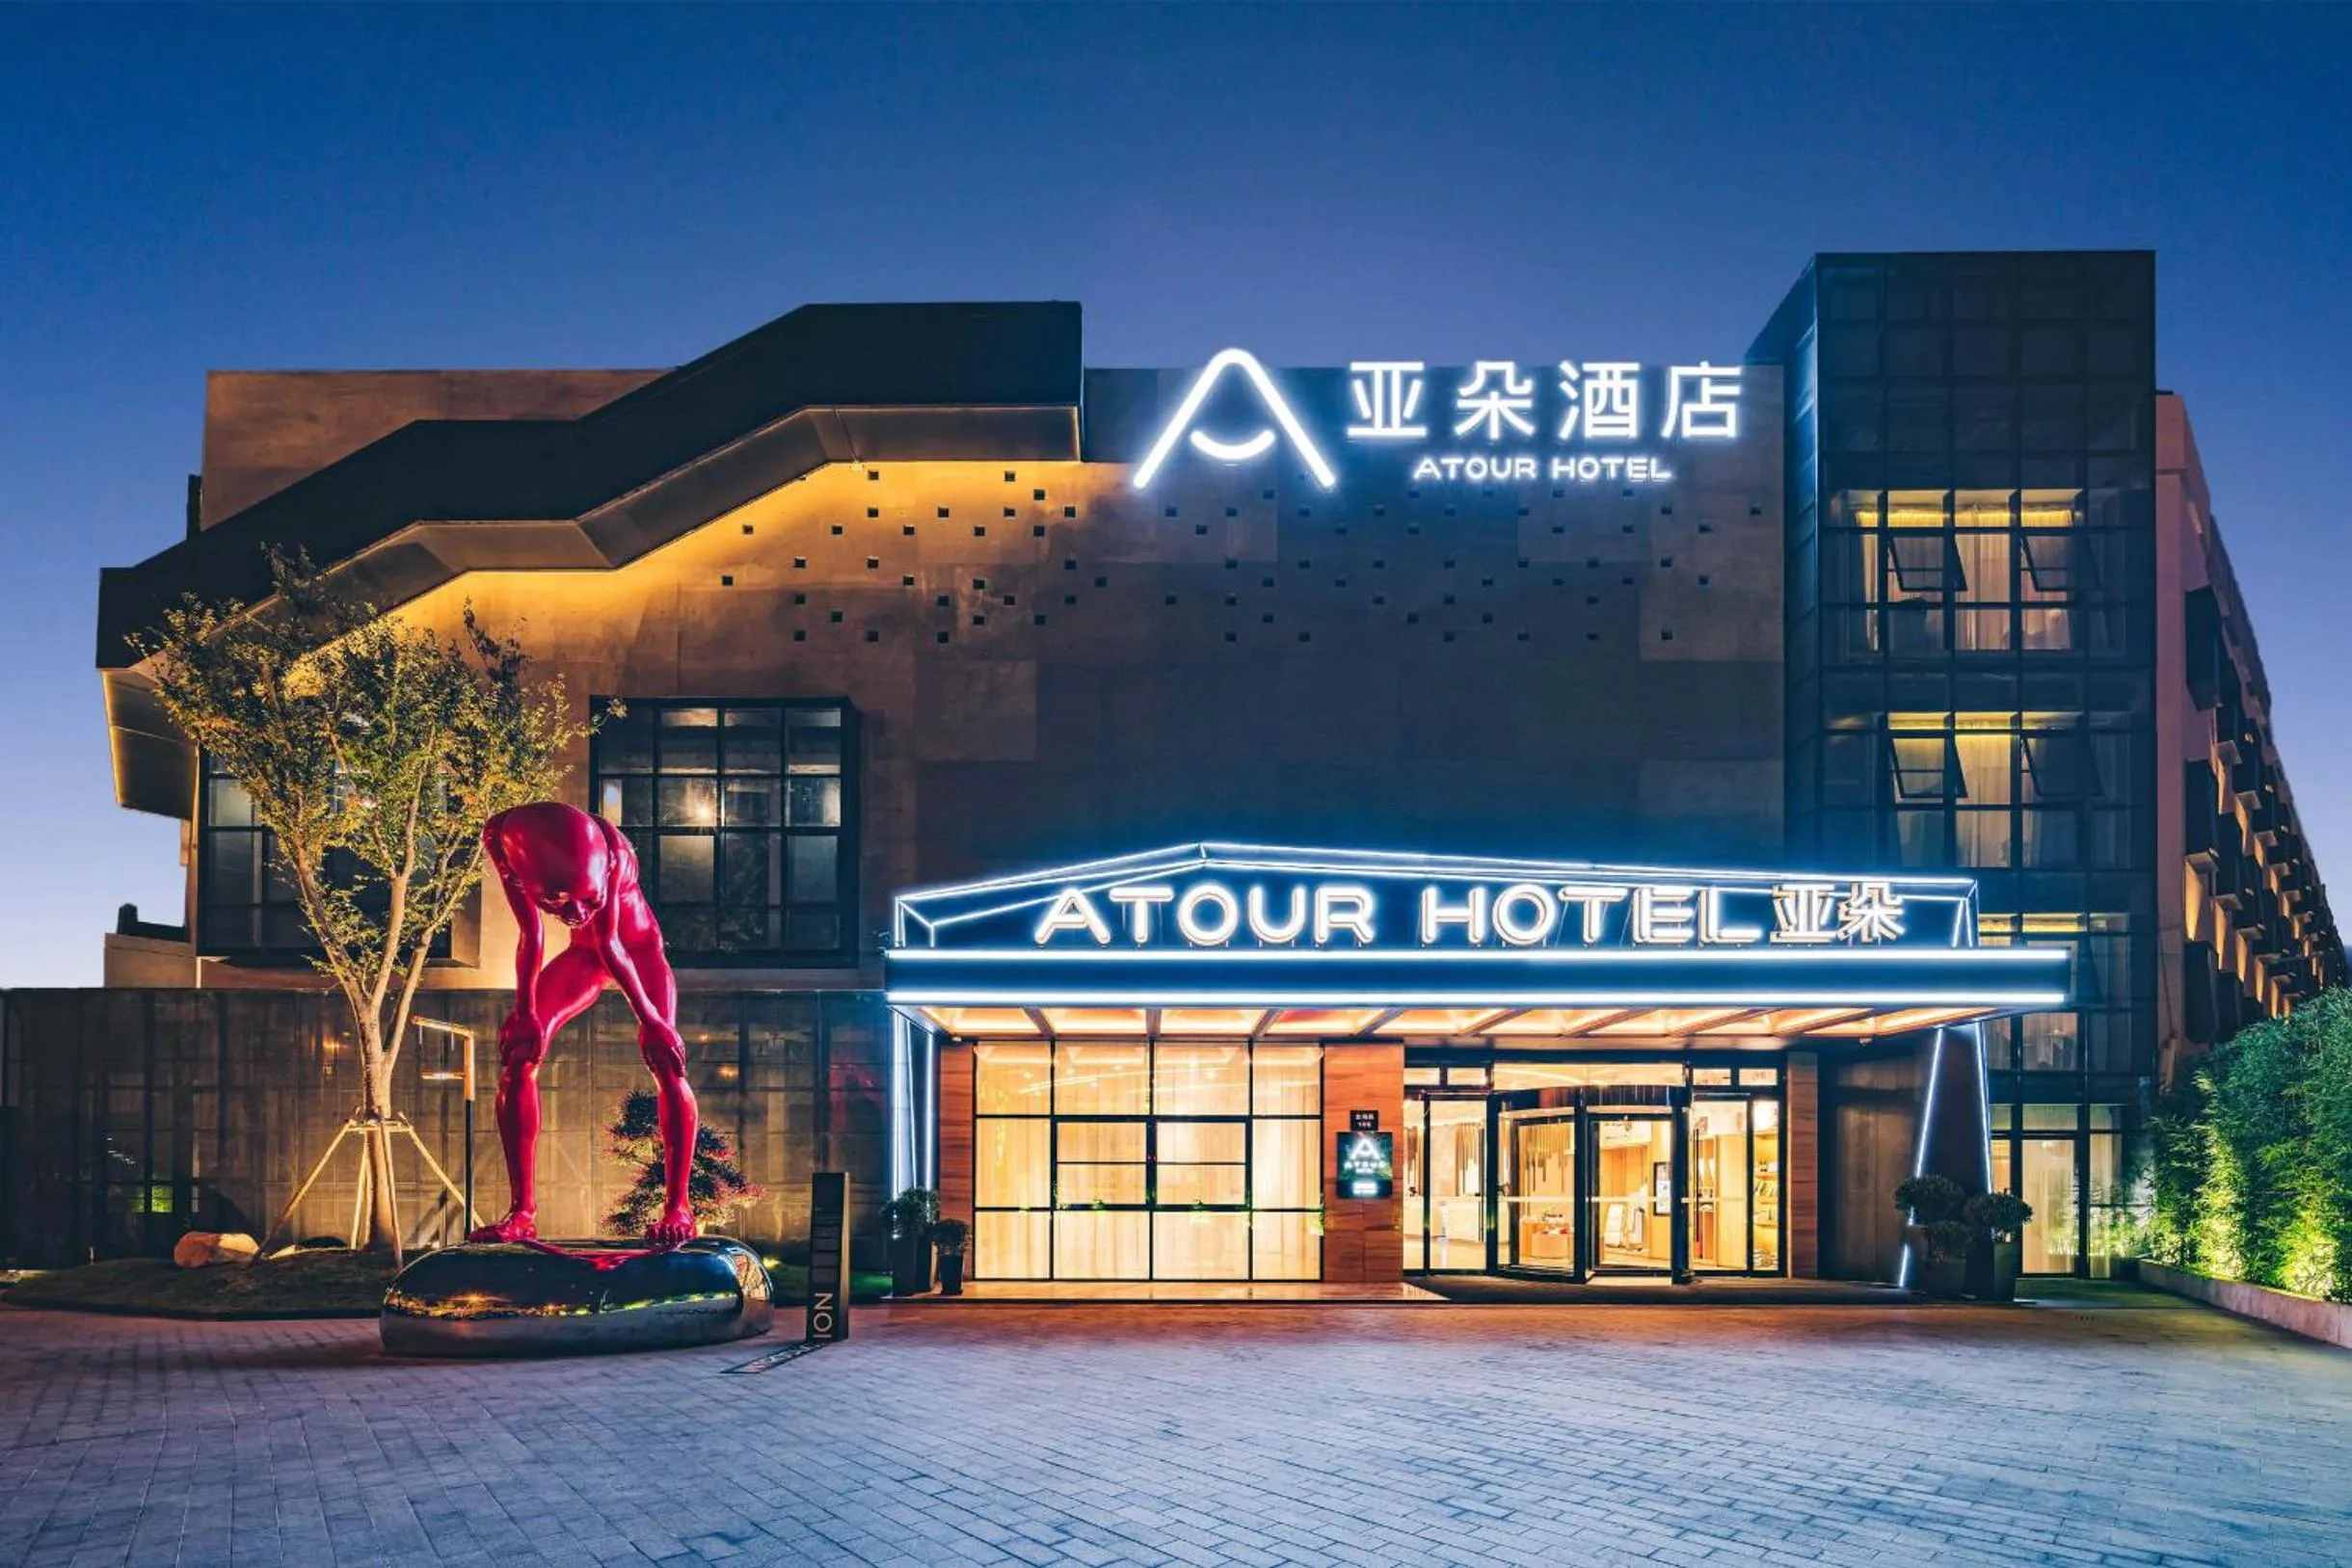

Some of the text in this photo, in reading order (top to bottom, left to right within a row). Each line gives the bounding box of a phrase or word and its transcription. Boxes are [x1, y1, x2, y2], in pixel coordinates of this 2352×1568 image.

[1347, 359, 1741, 440] 亚朵酒店
[1413, 456, 1671, 482] ATOUR HOTEL
[1033, 882, 1906, 945] ATOUR HOTEL 亚朵
